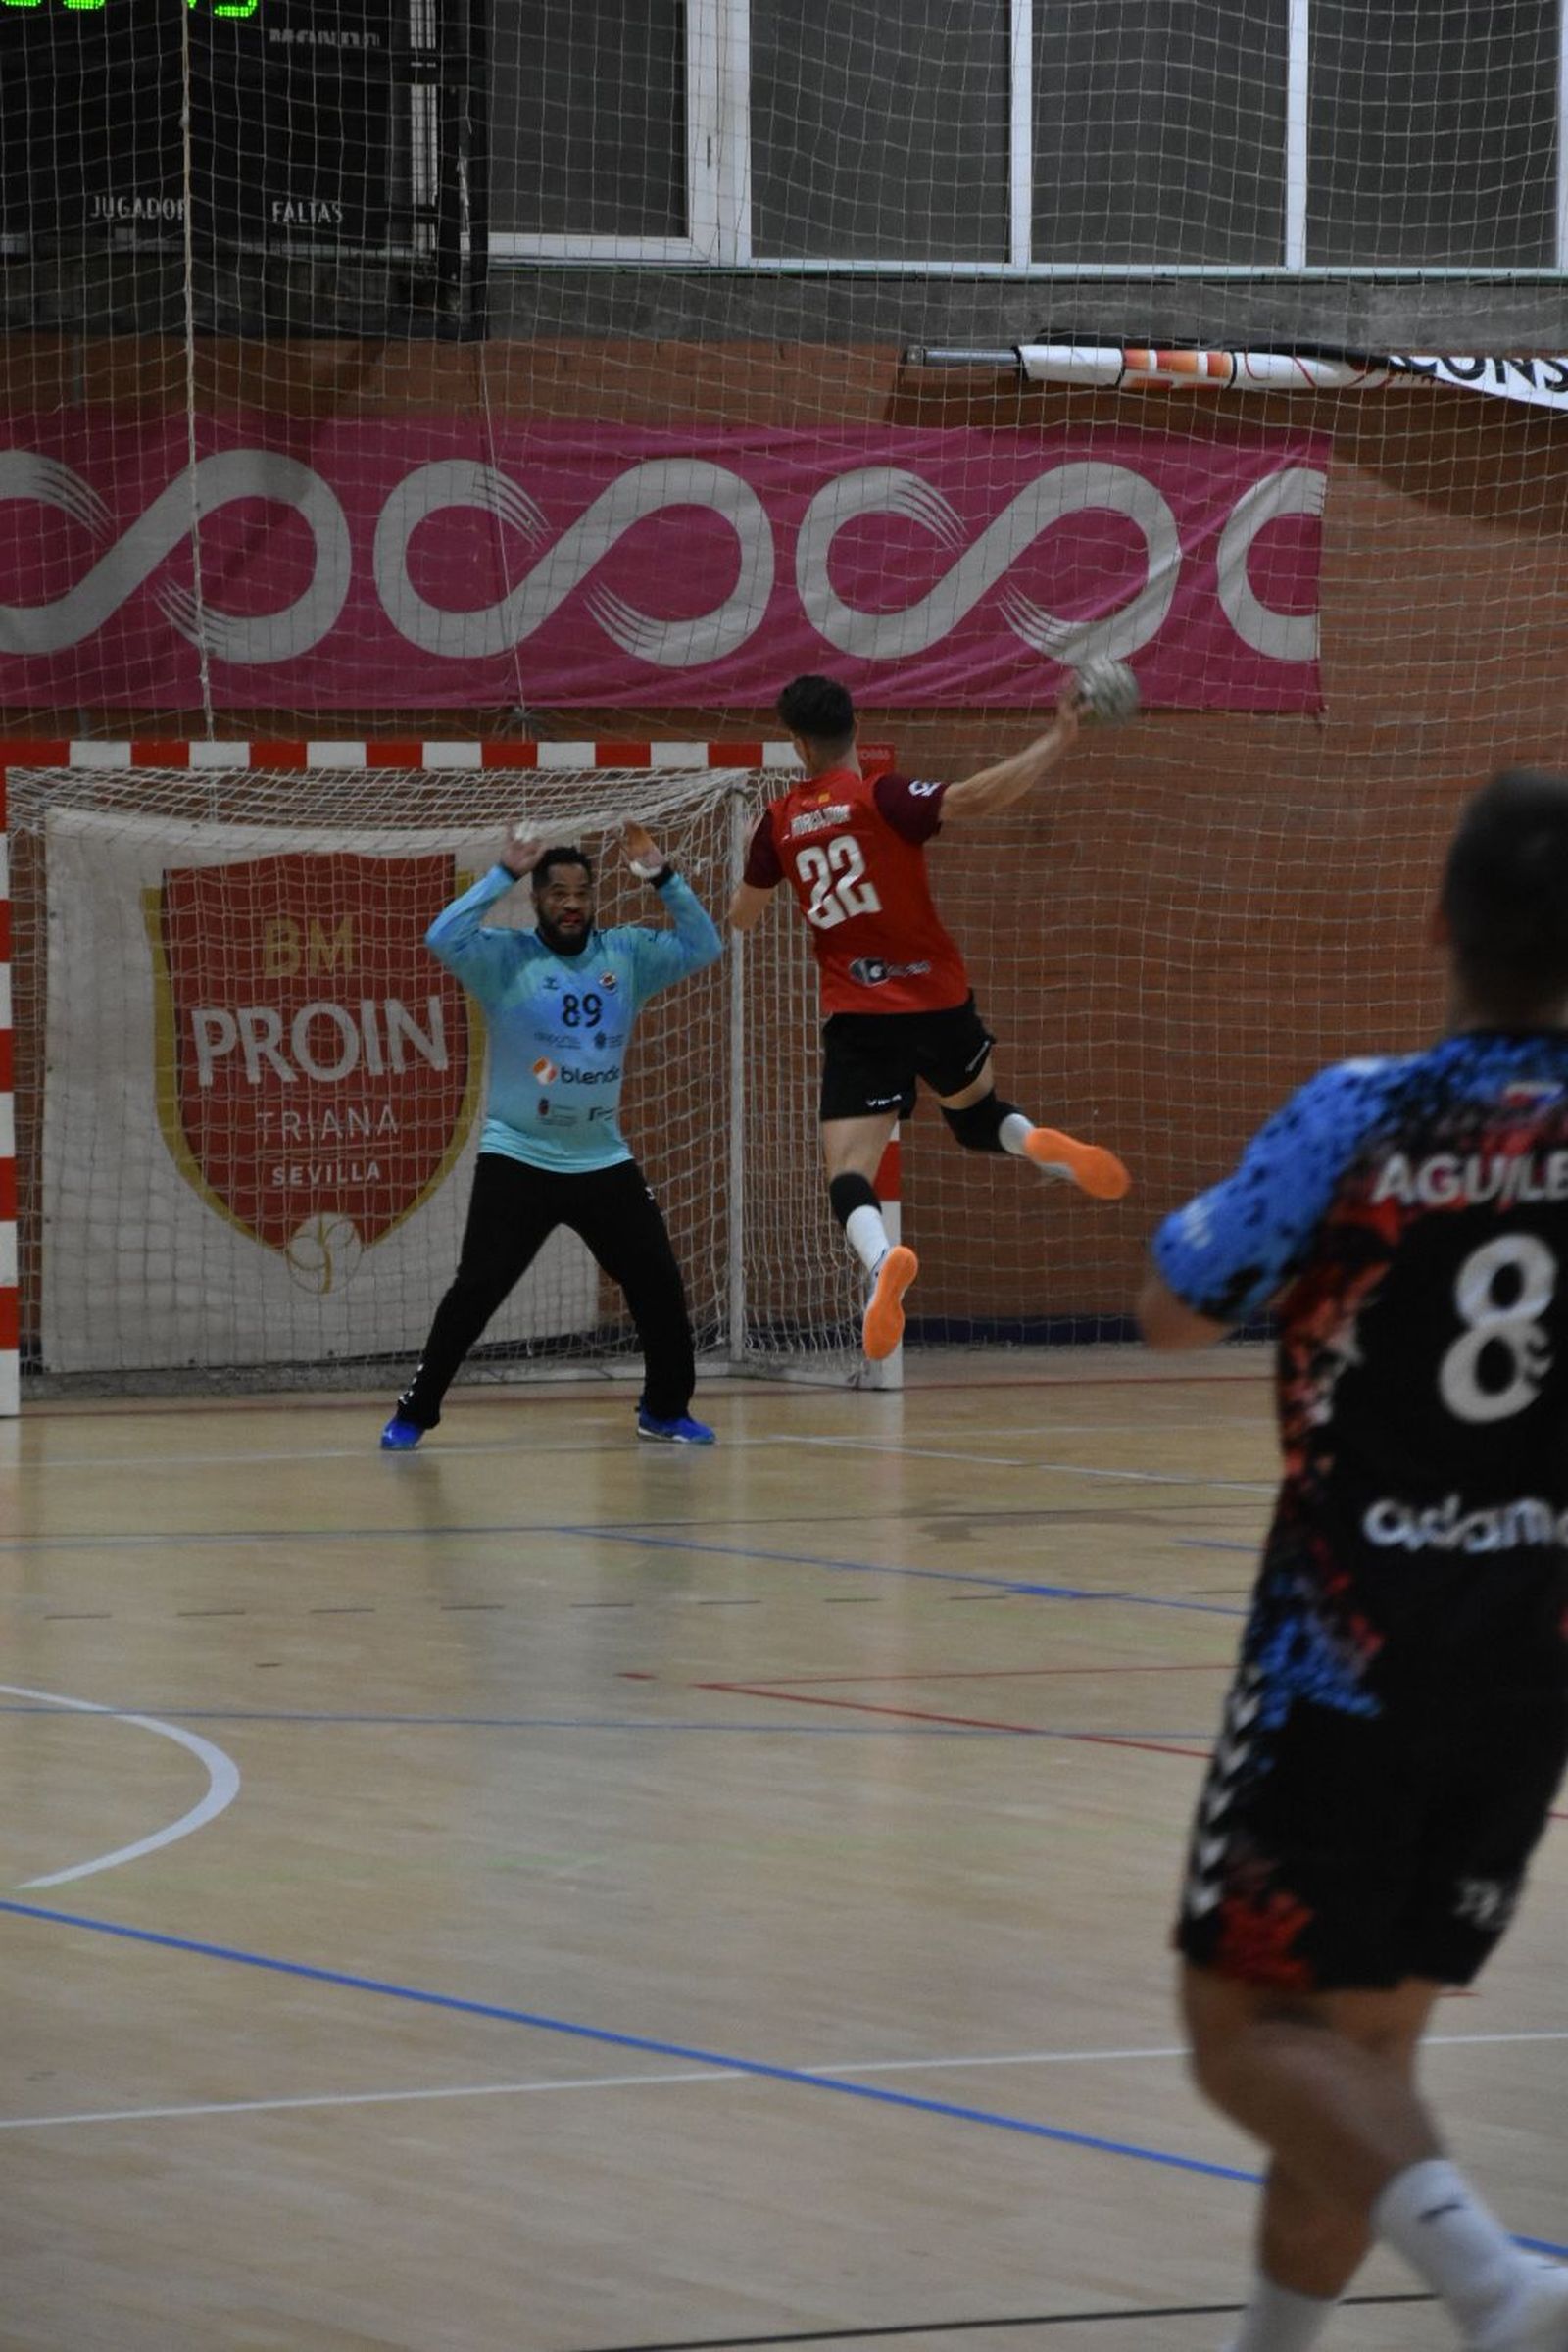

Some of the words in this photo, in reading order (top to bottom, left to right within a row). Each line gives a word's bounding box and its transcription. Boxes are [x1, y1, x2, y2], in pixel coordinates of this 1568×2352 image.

[272, 201, 343, 224] FALTAS
[795, 835, 882, 930] 22
[263, 915, 354, 977] BM
[562, 993, 603, 1028] 89
[191, 996, 449, 1088] PROIN
[257, 1104, 400, 1143] TRIANA
[271, 1161, 382, 1186] SEVILLA
[1438, 1232, 1558, 1424] 8
